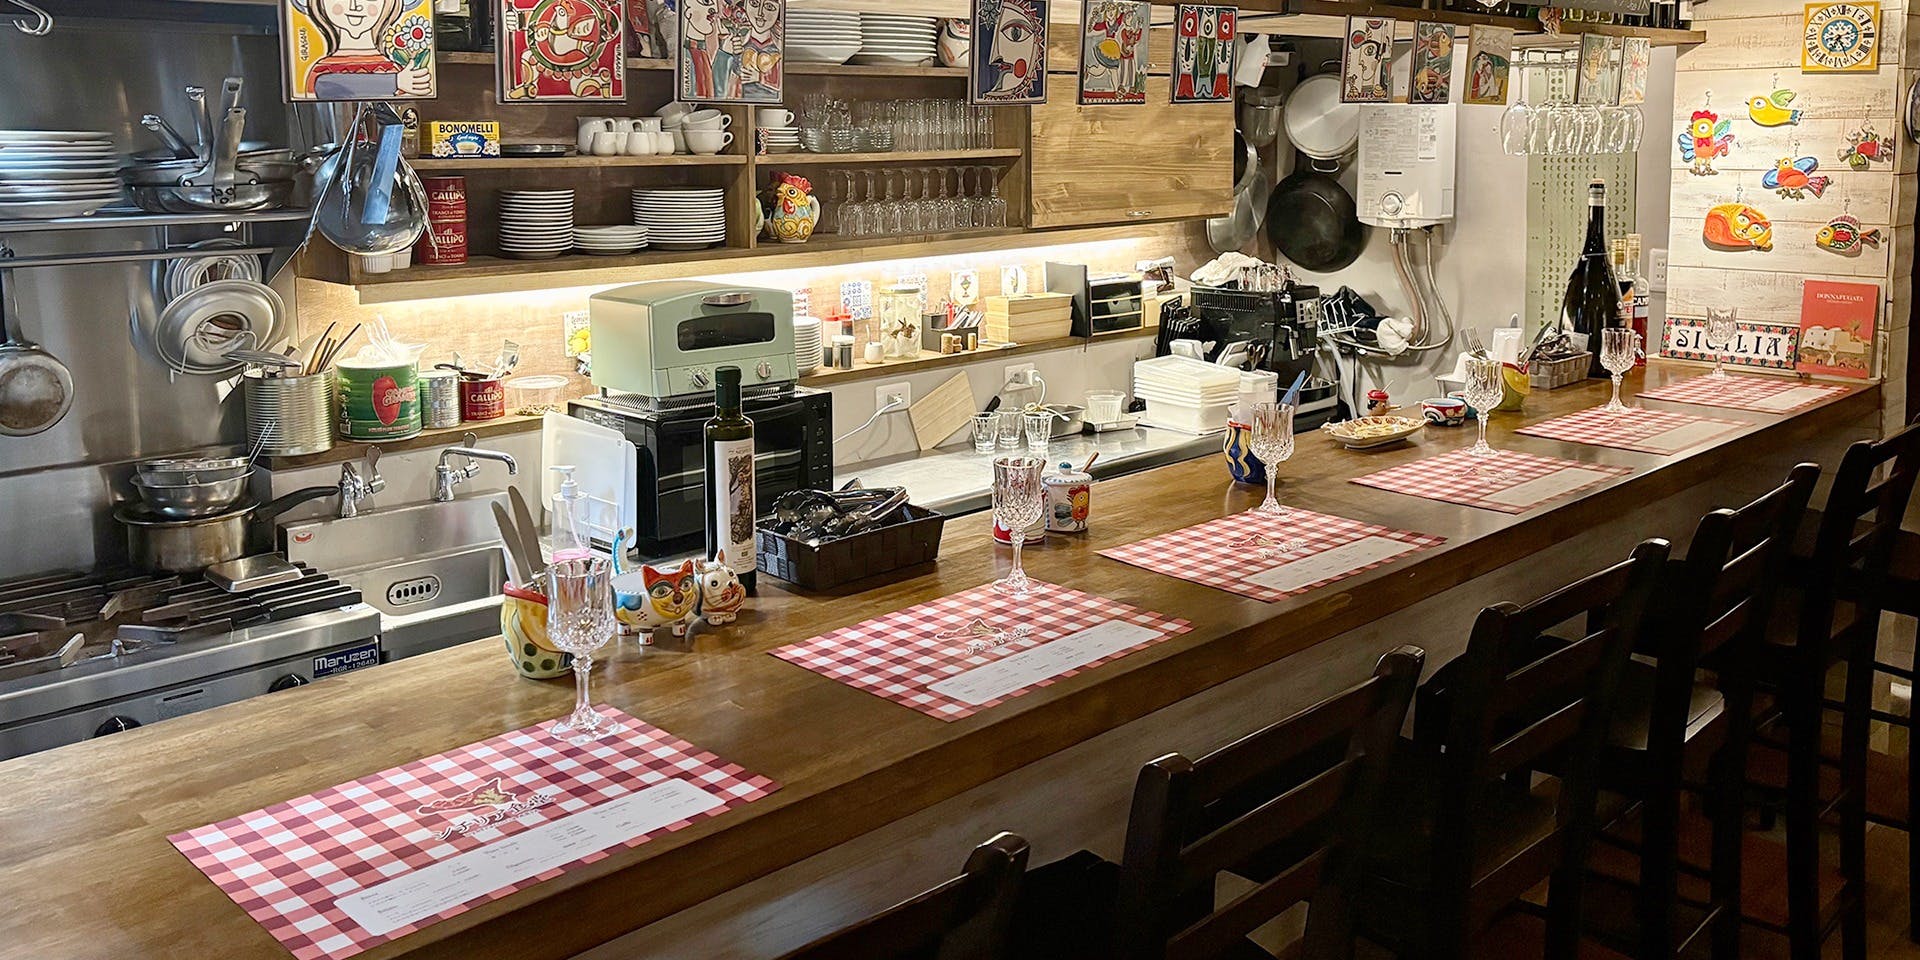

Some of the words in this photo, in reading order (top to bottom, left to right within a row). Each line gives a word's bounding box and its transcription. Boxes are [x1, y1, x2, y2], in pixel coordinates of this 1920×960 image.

[439, 123, 494, 134] BONOMELLI
[432, 190, 466, 200] CALLIPO
[436, 234, 465, 245] ALLIPO
[314, 648, 377, 671] Maruzen
